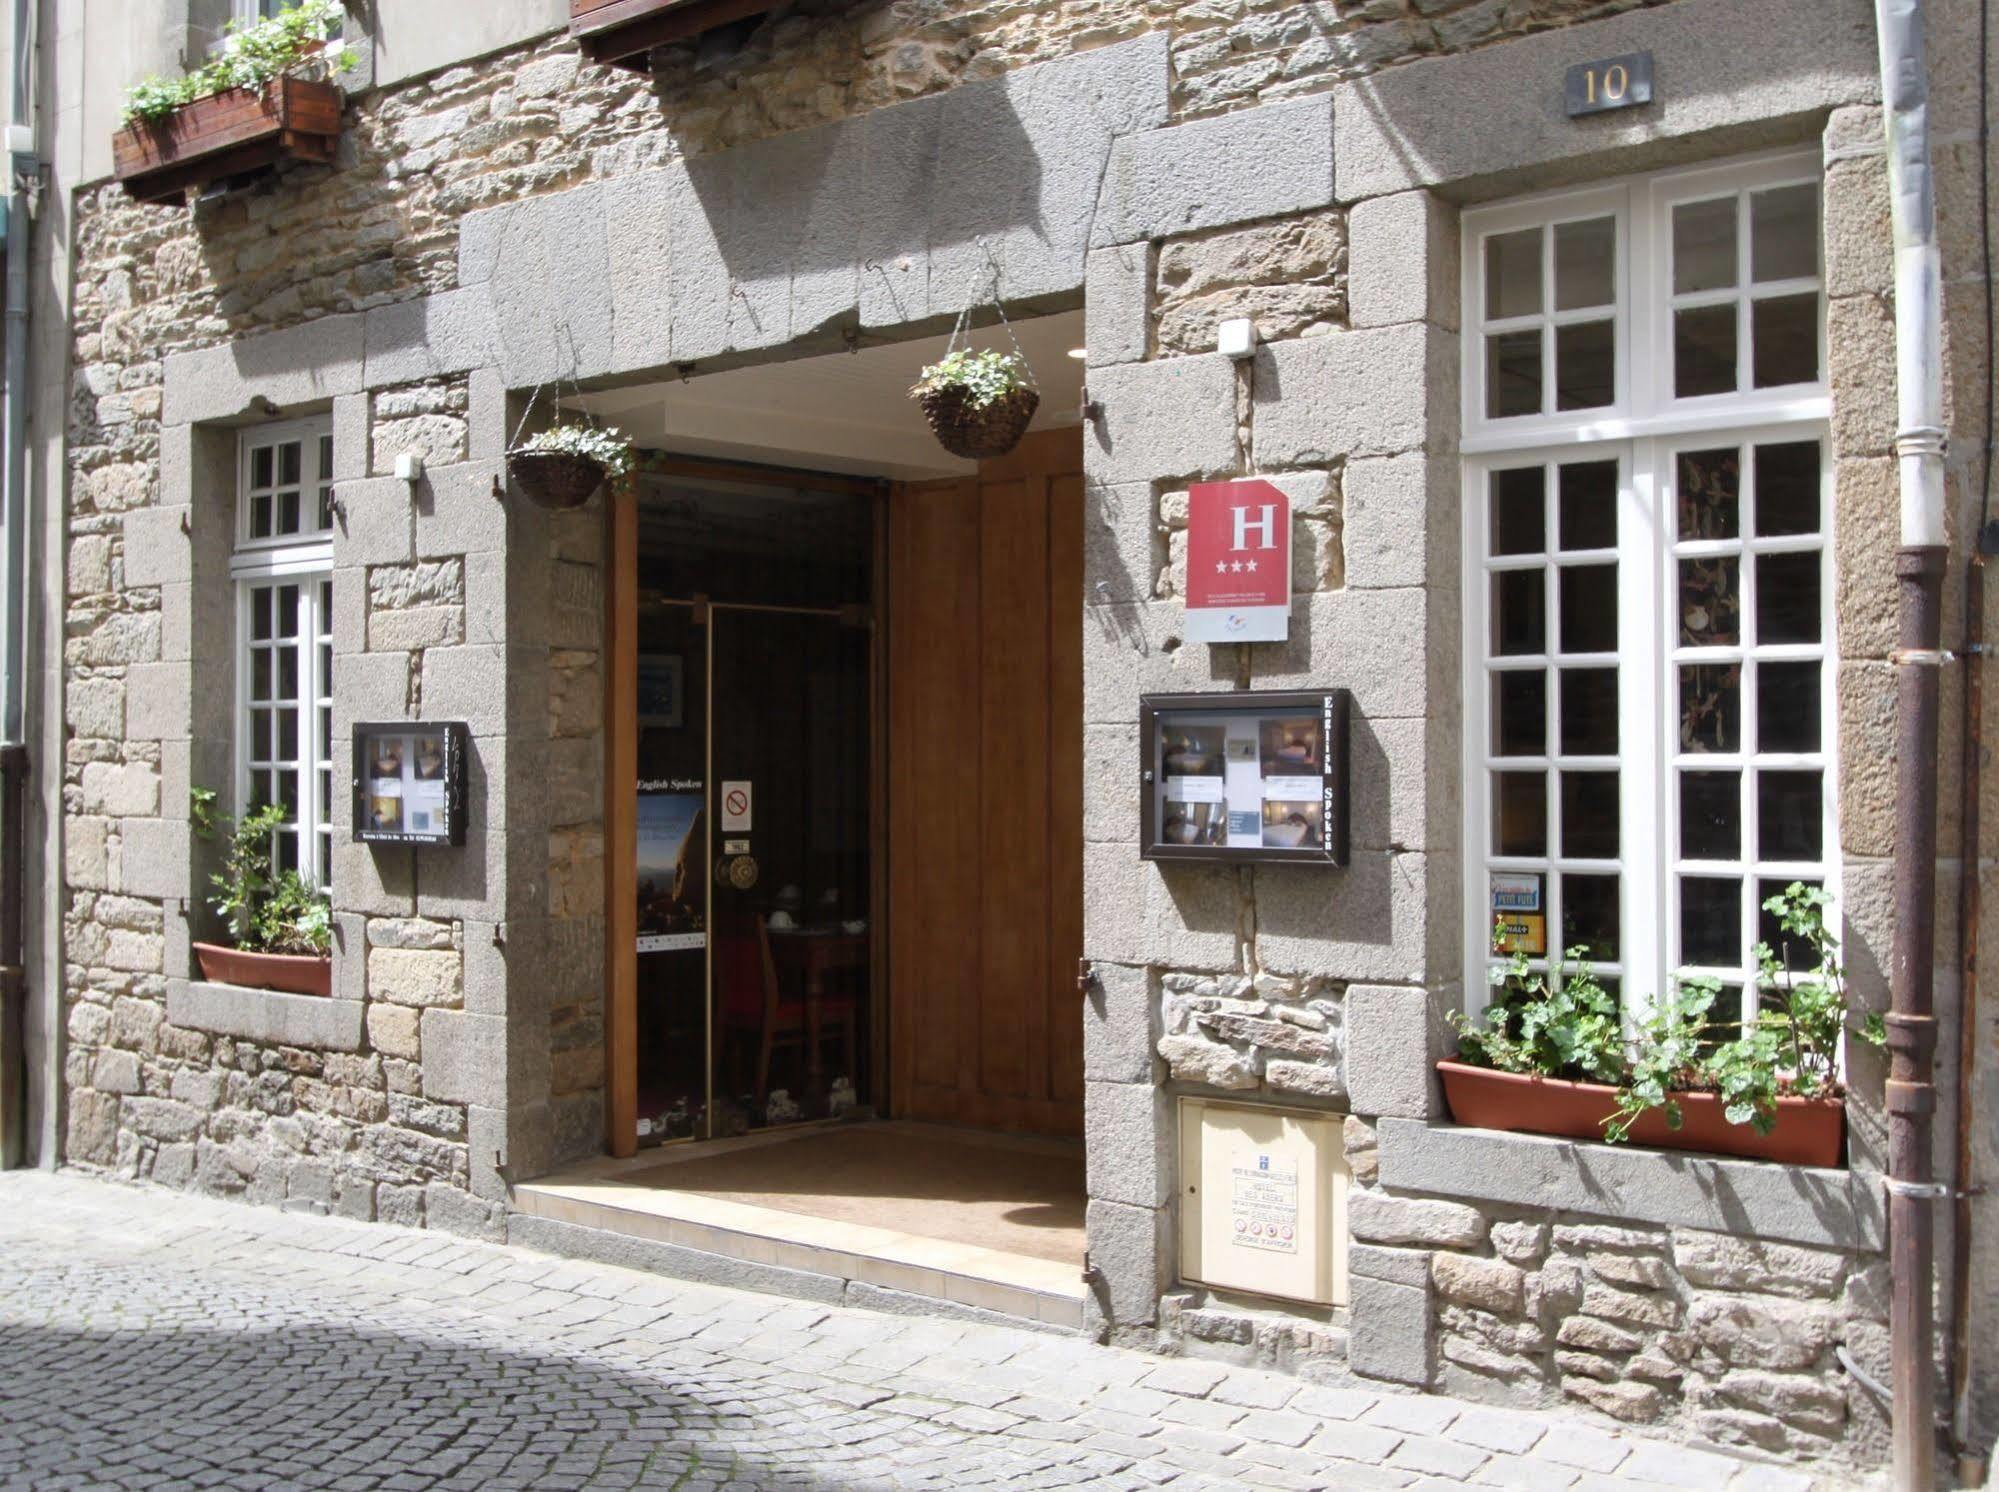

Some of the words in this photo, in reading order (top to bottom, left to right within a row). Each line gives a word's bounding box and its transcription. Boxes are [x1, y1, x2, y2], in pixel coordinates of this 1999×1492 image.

[1584, 65, 1628, 104] 10
[1229, 504, 1278, 551] H
[1323, 696, 1333, 774] English
[636, 779, 668, 791] English
[671, 779, 702, 790] Spoken
[1323, 788, 1333, 850] Spoken
